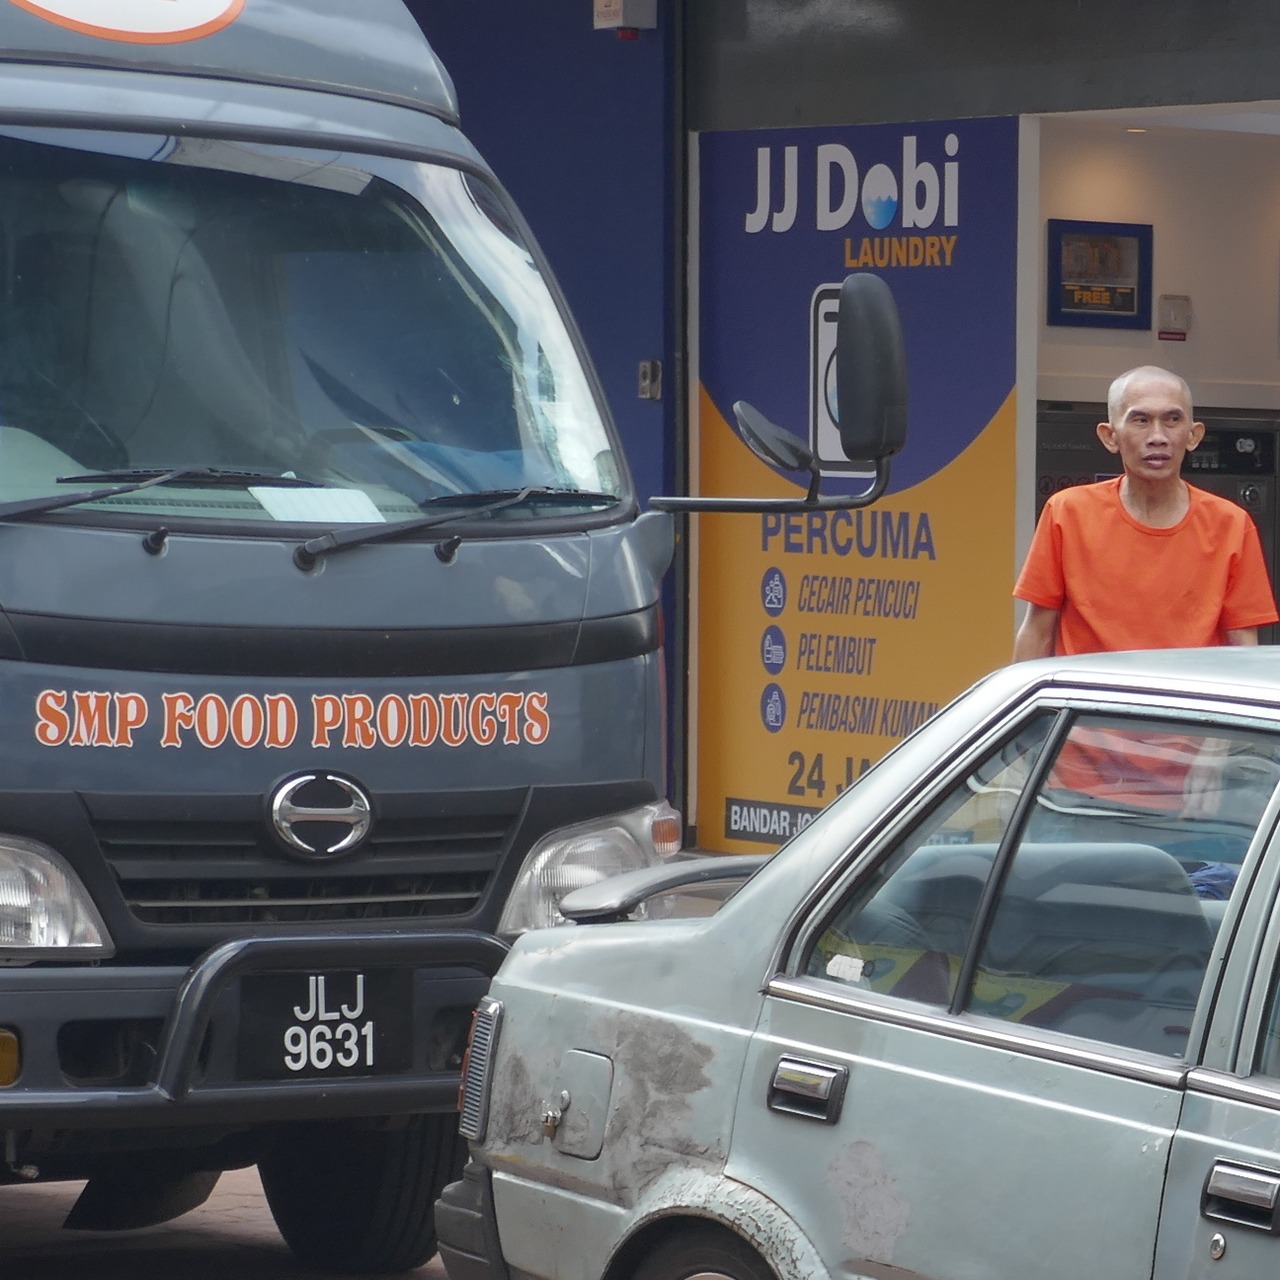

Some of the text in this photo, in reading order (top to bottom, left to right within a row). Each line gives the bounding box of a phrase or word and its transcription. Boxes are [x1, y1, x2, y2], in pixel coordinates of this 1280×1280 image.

[745, 133, 959, 233] JJ Dobi
[845, 235, 958, 268] LAUNDRY
[1074, 290, 1111, 305] FREE
[761, 509, 937, 561] PERCUMA
[798, 575, 921, 619] CECAIR PENCUCI
[797, 633, 877, 676] PELEMBUT
[34, 689, 550, 749] SMP FOOD PRODUCTS
[796, 691, 880, 736] PEMBASMI
[787, 751, 826, 799] 24
[730, 804, 791, 837] BANDAR
[293, 974, 365, 1022] JLJ
[282, 1020, 375, 1071] 9631
